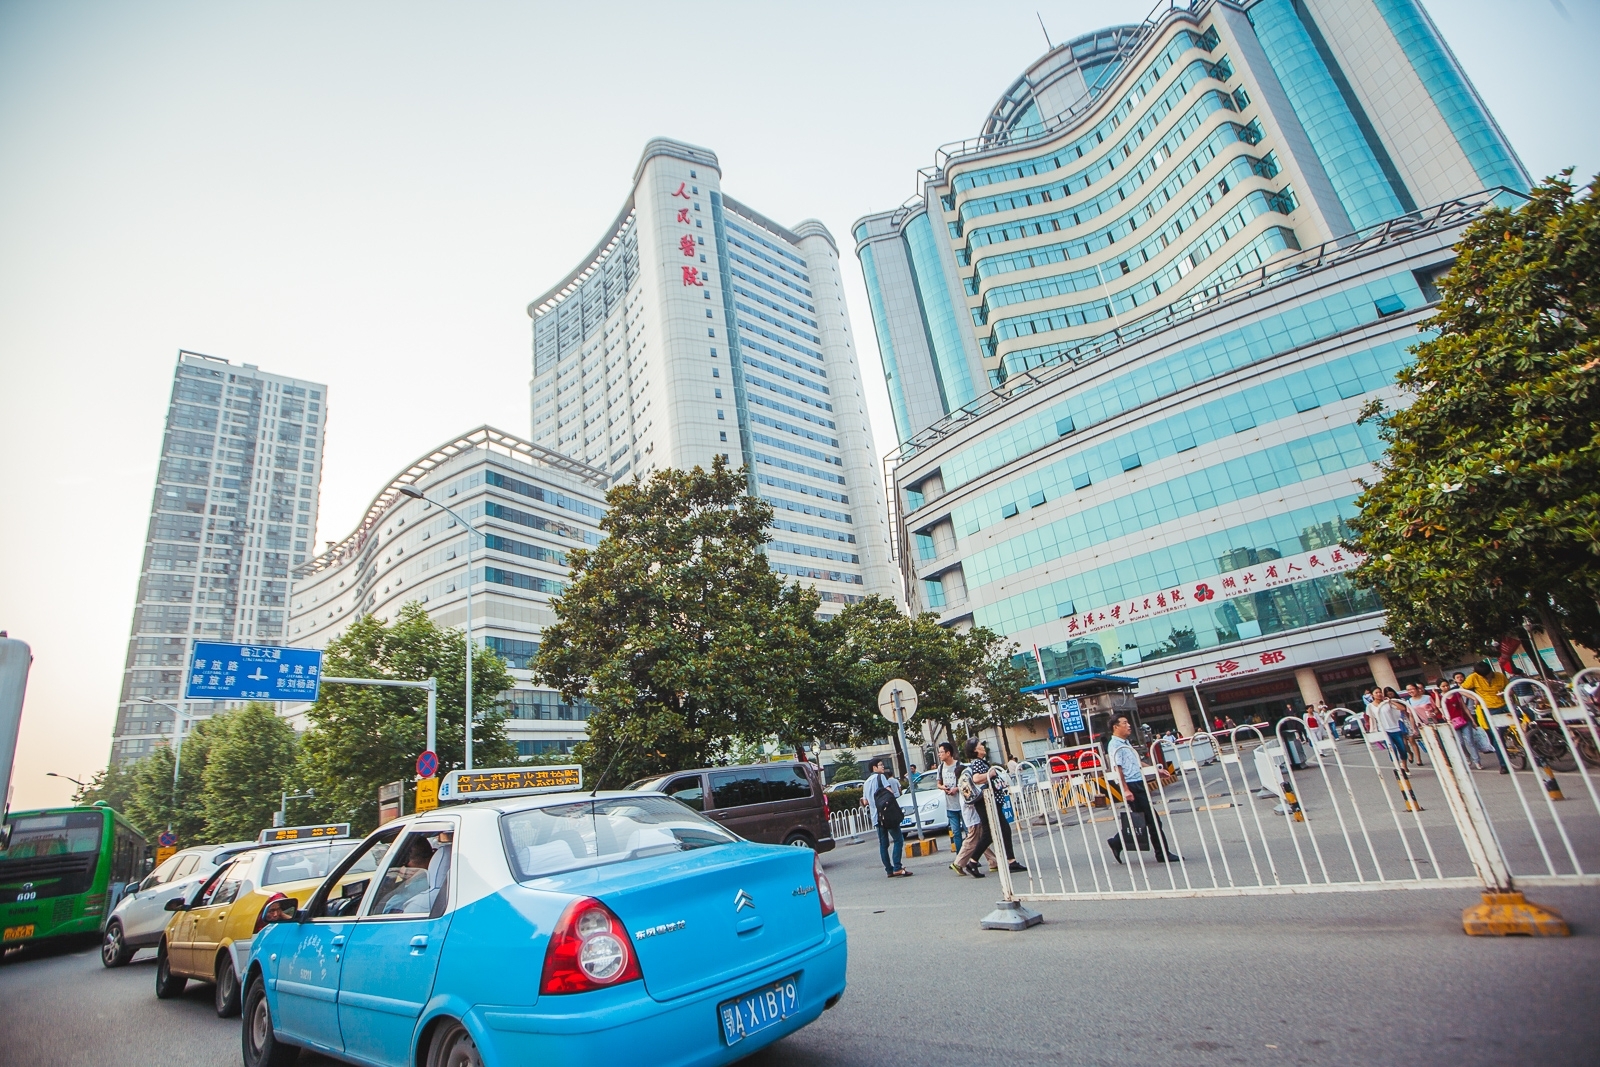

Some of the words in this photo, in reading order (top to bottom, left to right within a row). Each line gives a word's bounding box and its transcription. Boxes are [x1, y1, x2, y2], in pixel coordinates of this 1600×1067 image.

[1225, 587, 1252, 597] HUBEI
[1265, 574, 1308, 587] GENERAL
[1090, 623, 1114, 632] HOSPITAL
[1130, 614, 1150, 622] WUHAN
[1153, 603, 1187, 616] UNIVERSITY
[241, 647, 281, 660] 临江大道
[195, 659, 239, 672] 解放路
[279, 664, 318, 676] 解放路
[1175, 650, 1286, 683] 门诊部
[191, 675, 236, 687] 解放桥
[1202, 674, 1228, 682] OUTPATIENT
[1231, 667, 1260, 676] DEPARTMENT
